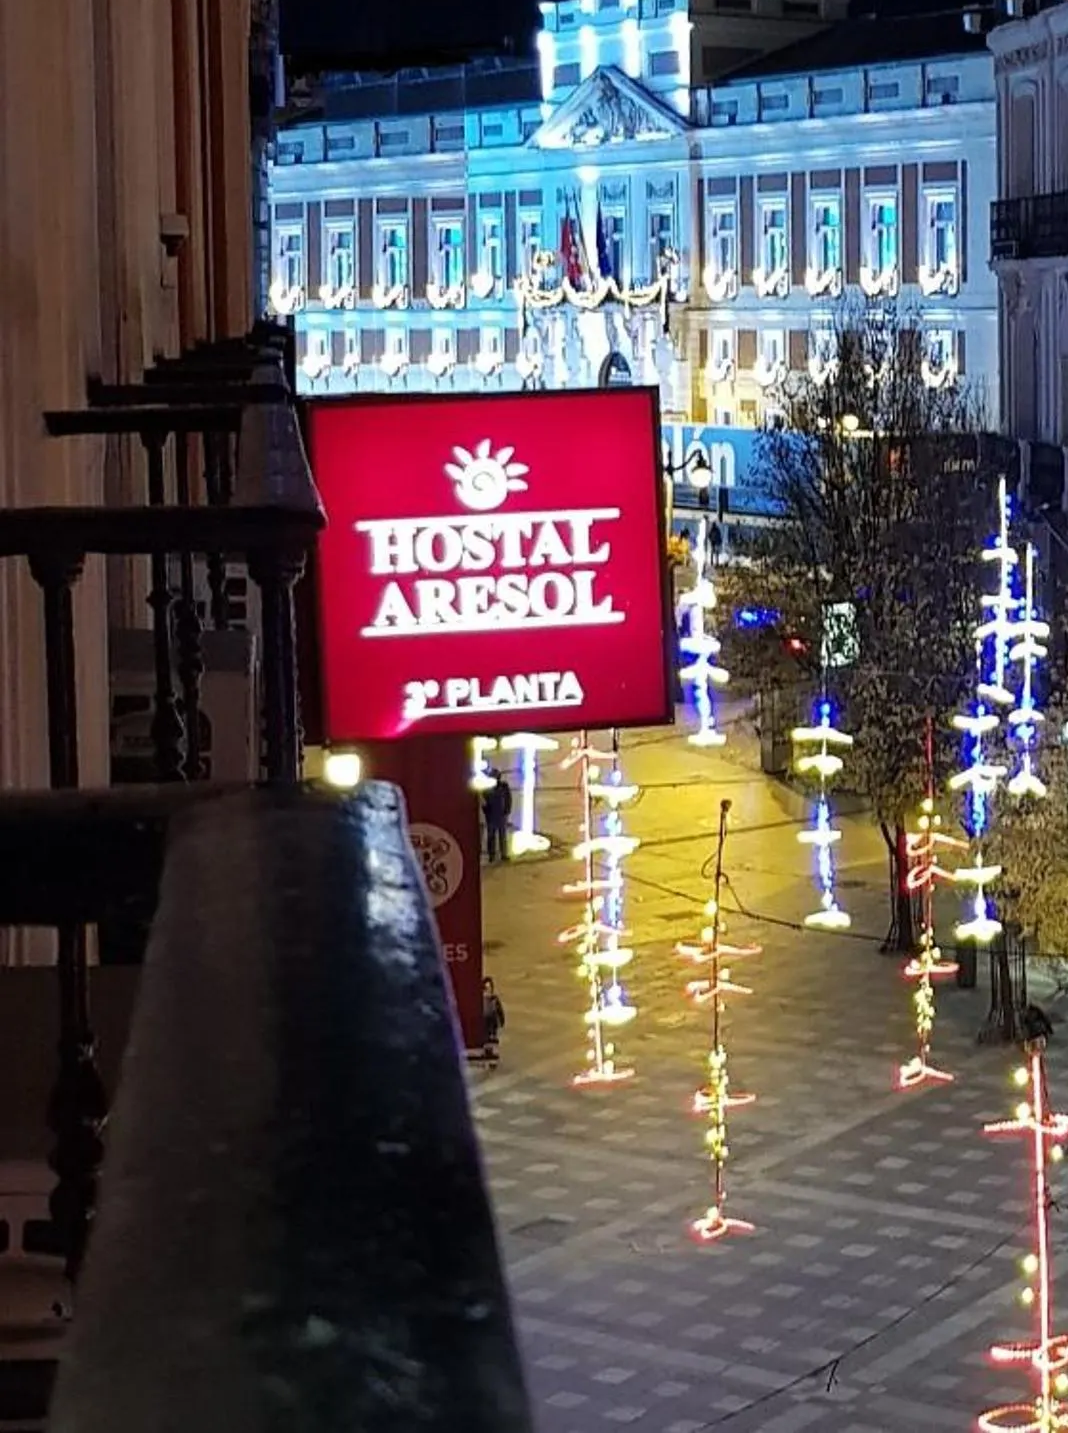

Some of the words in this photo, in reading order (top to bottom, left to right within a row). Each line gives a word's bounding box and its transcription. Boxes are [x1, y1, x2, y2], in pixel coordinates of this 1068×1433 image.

[661, 426, 735, 488] lón
[368, 515, 610, 575] HOSTAL
[373, 570, 612, 628] ARESOL
[445, 671, 584, 709] PLANTA
